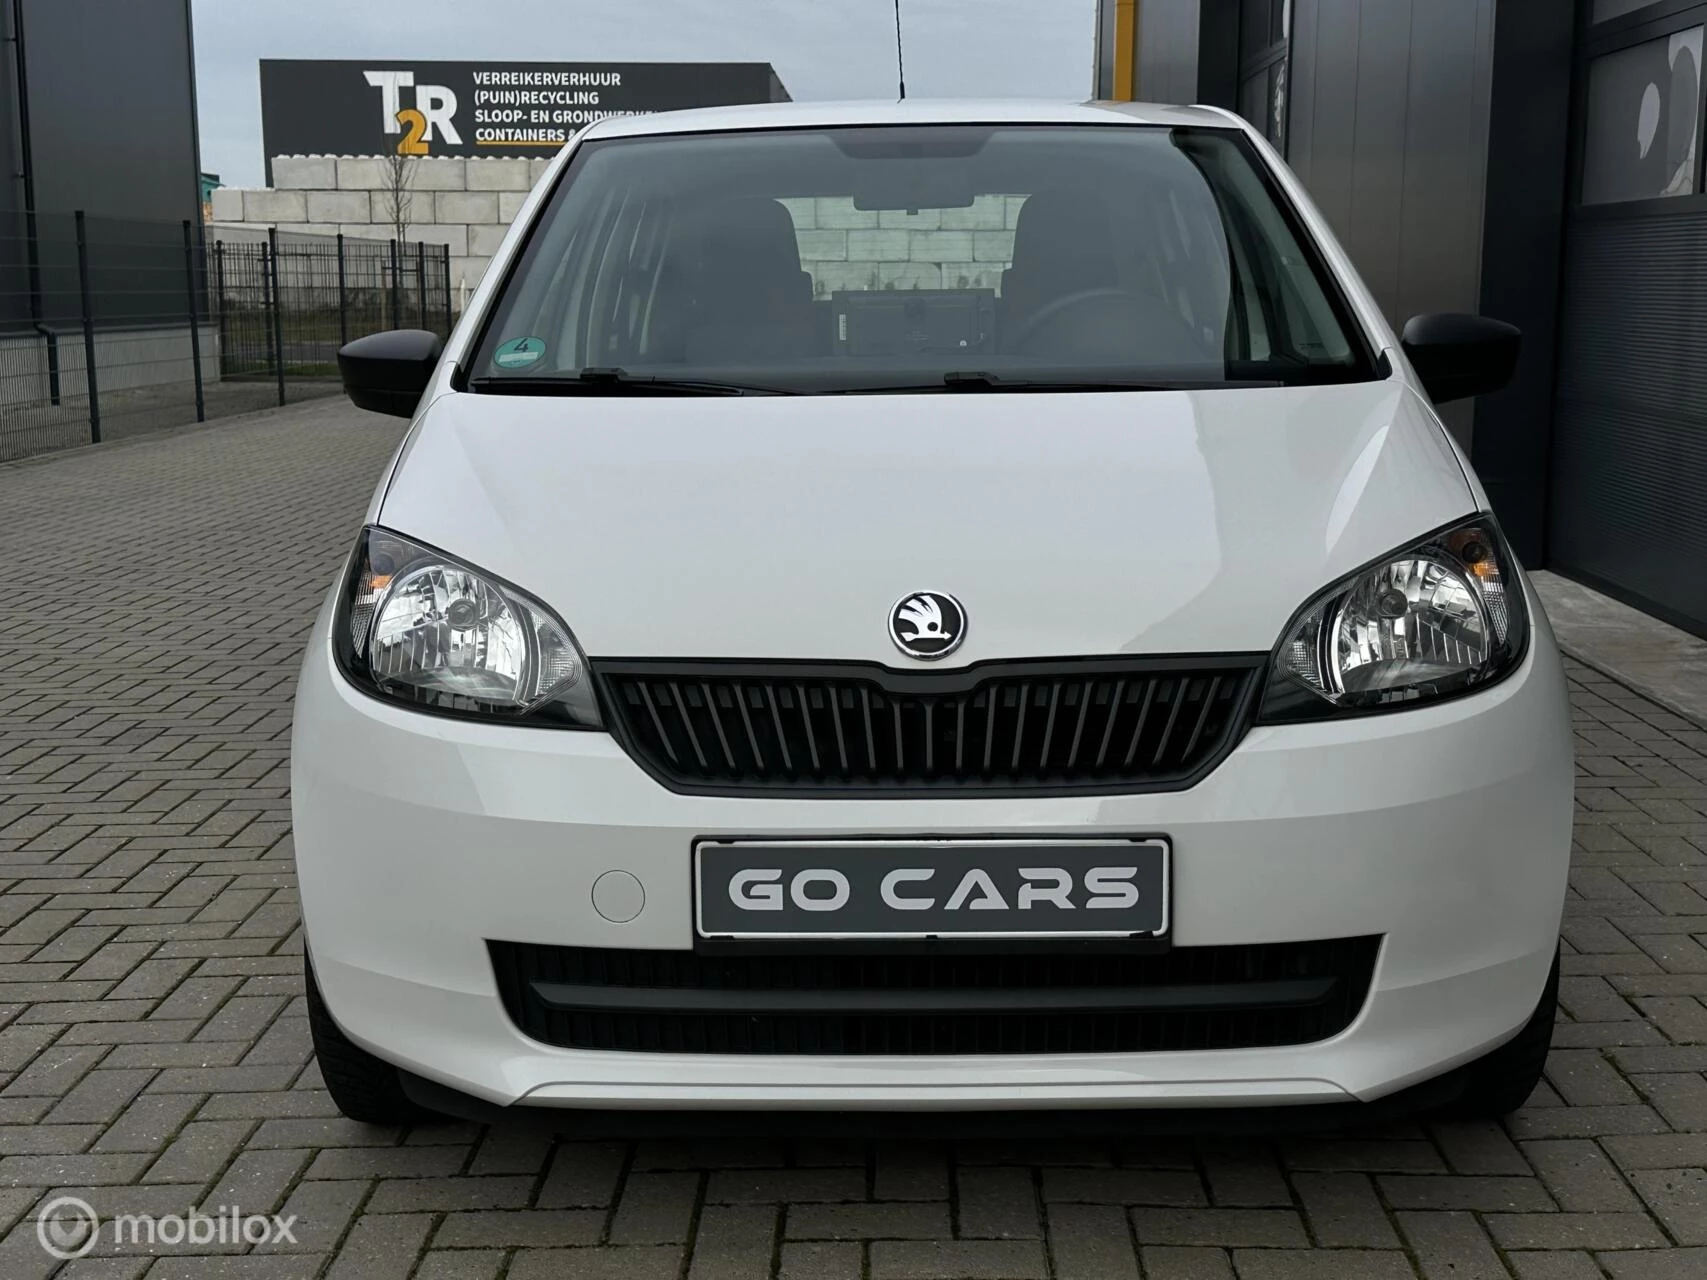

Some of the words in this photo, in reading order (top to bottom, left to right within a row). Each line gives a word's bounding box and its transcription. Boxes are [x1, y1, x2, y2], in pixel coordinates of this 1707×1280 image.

[473, 72, 621, 86] VERREIKERVERHUUR
[474, 90, 599, 106] (PUIN)RECYCLING
[475, 110, 528, 123] SLOOP-
[530, 111, 549, 123] EN
[475, 128, 565, 141] CONTAINERS
[514, 337, 528, 352] 4
[728, 868, 850, 911] GO
[880, 867, 1139, 911] CARS
